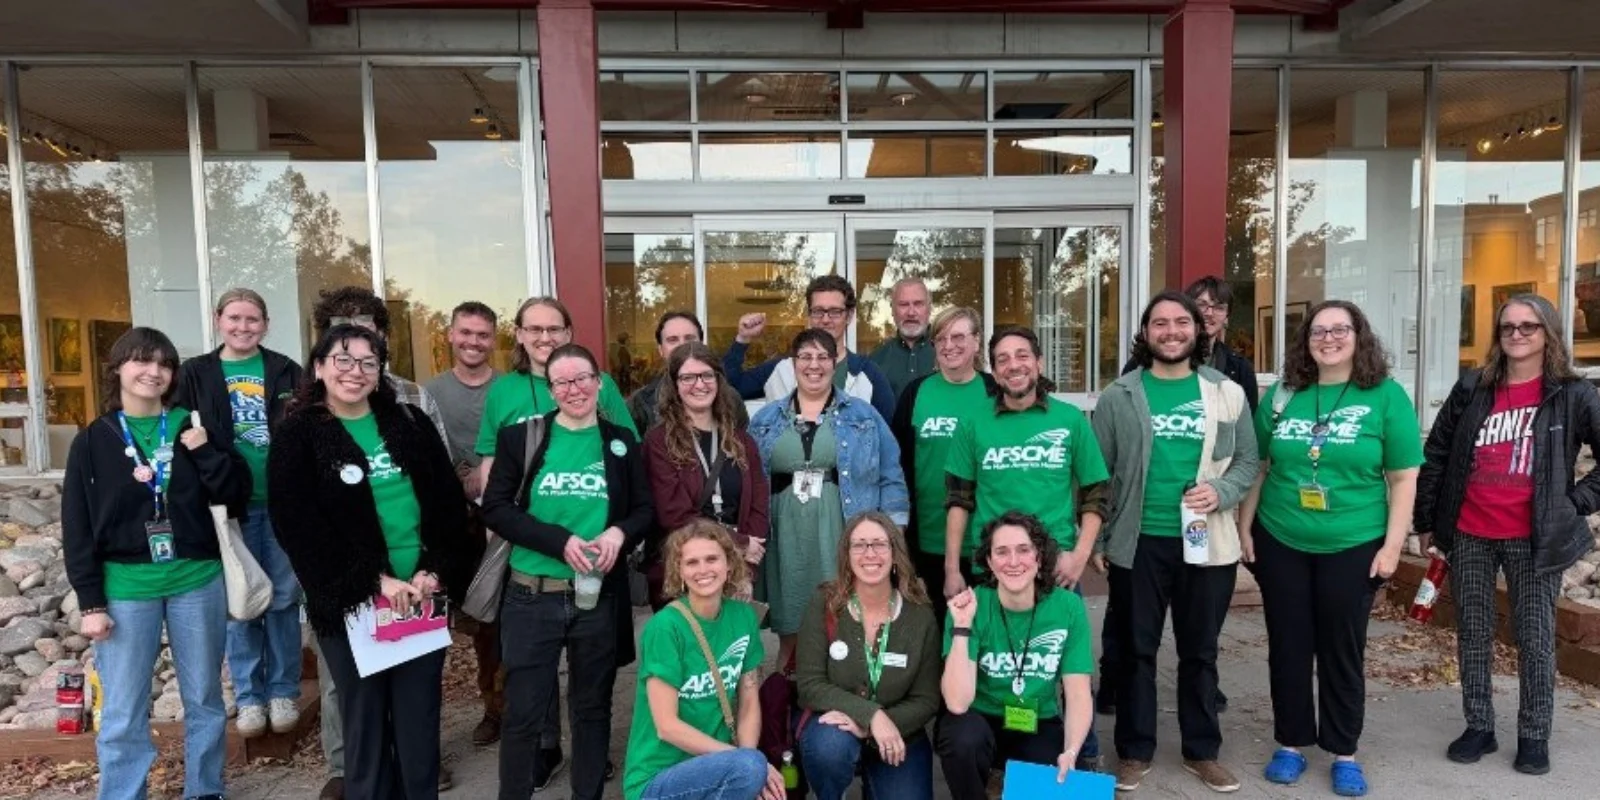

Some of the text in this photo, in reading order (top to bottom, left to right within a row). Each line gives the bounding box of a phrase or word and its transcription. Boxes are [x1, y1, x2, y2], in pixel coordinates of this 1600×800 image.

[920, 416, 958, 432] AFS
[1272, 418, 1362, 438] AFSME
[982, 446, 1066, 464] AFSCME
